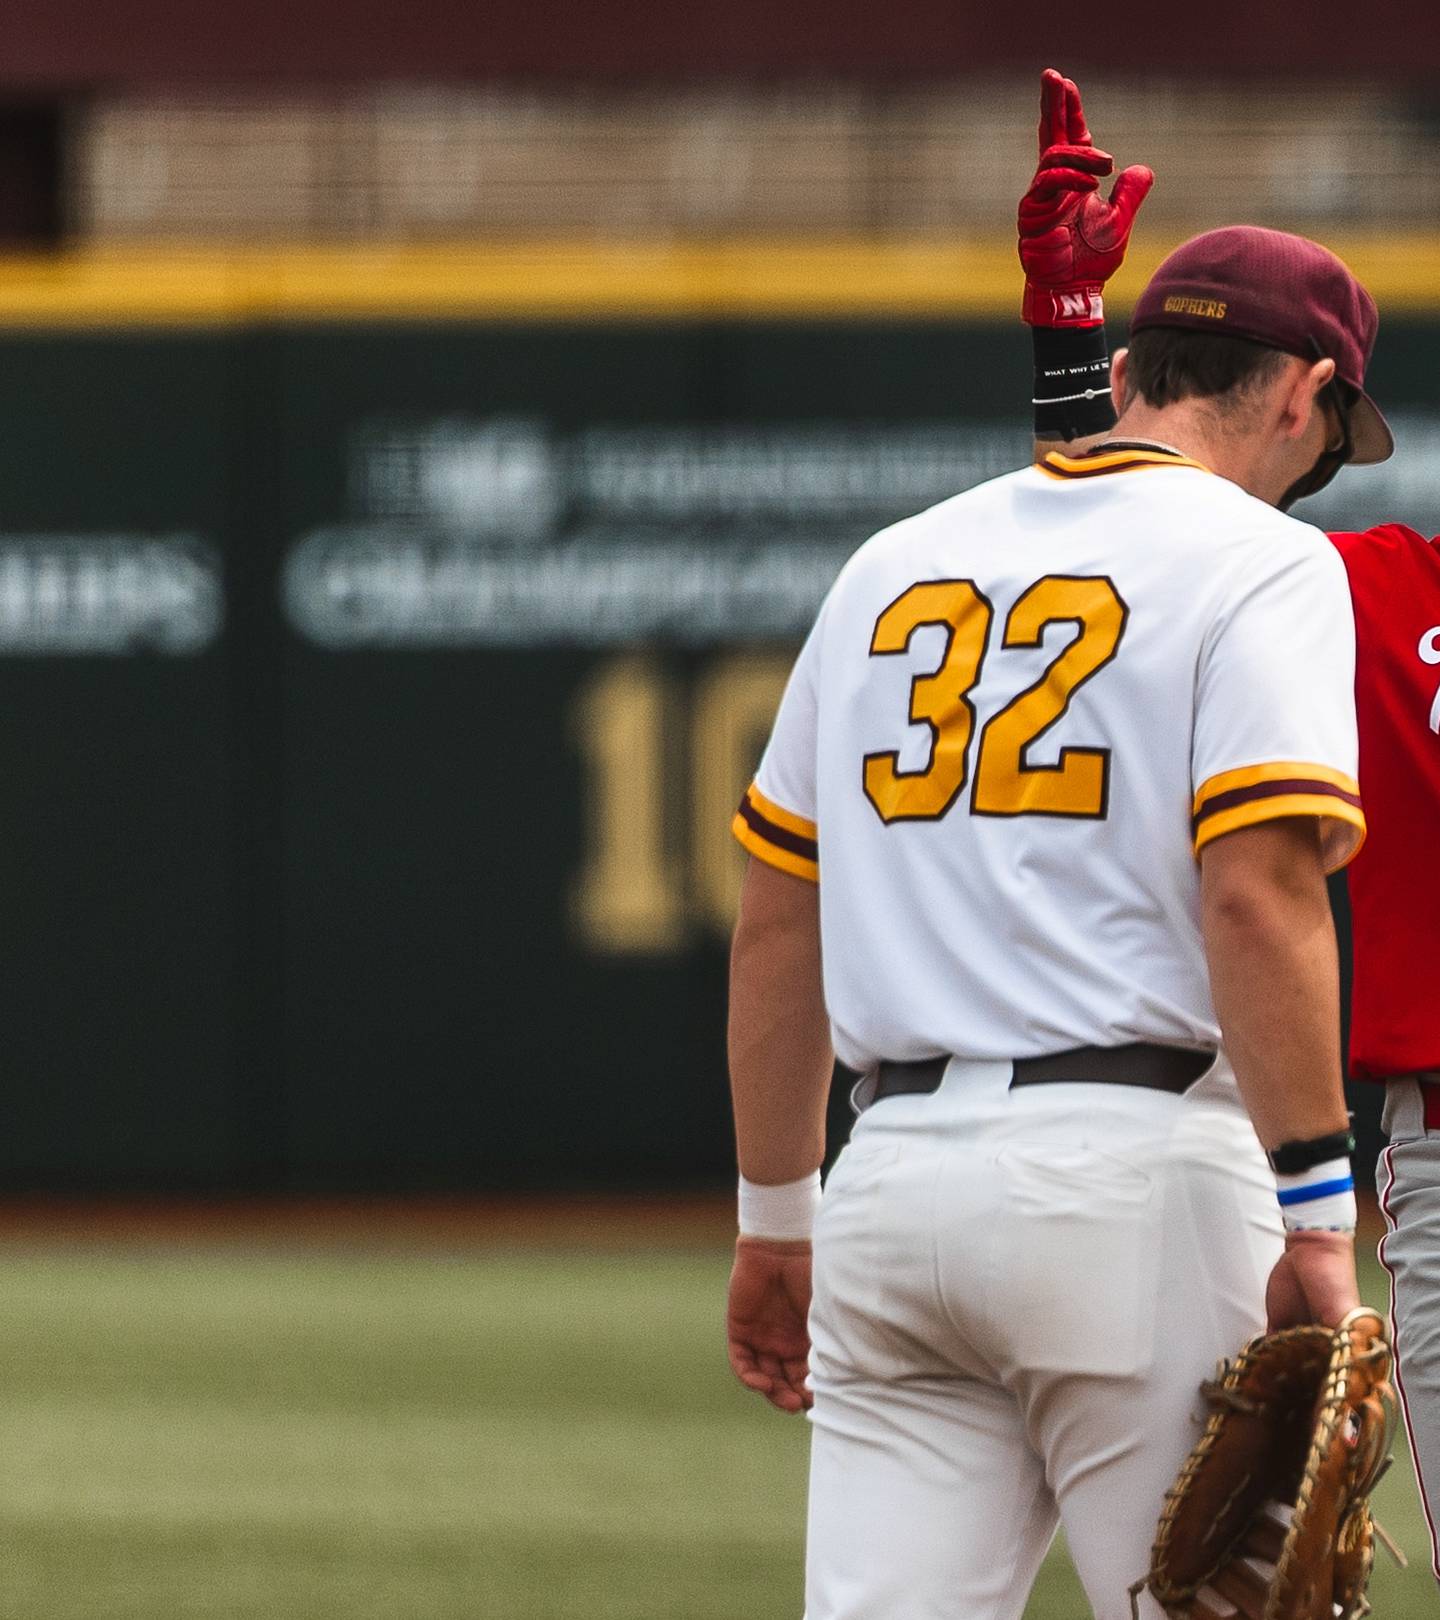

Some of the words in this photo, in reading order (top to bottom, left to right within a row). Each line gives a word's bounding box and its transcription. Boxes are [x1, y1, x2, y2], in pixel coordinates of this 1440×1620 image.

[1060, 293, 1085, 317] N
[1164, 296, 1228, 319] GOPHERS
[862, 574, 1130, 826] 32
